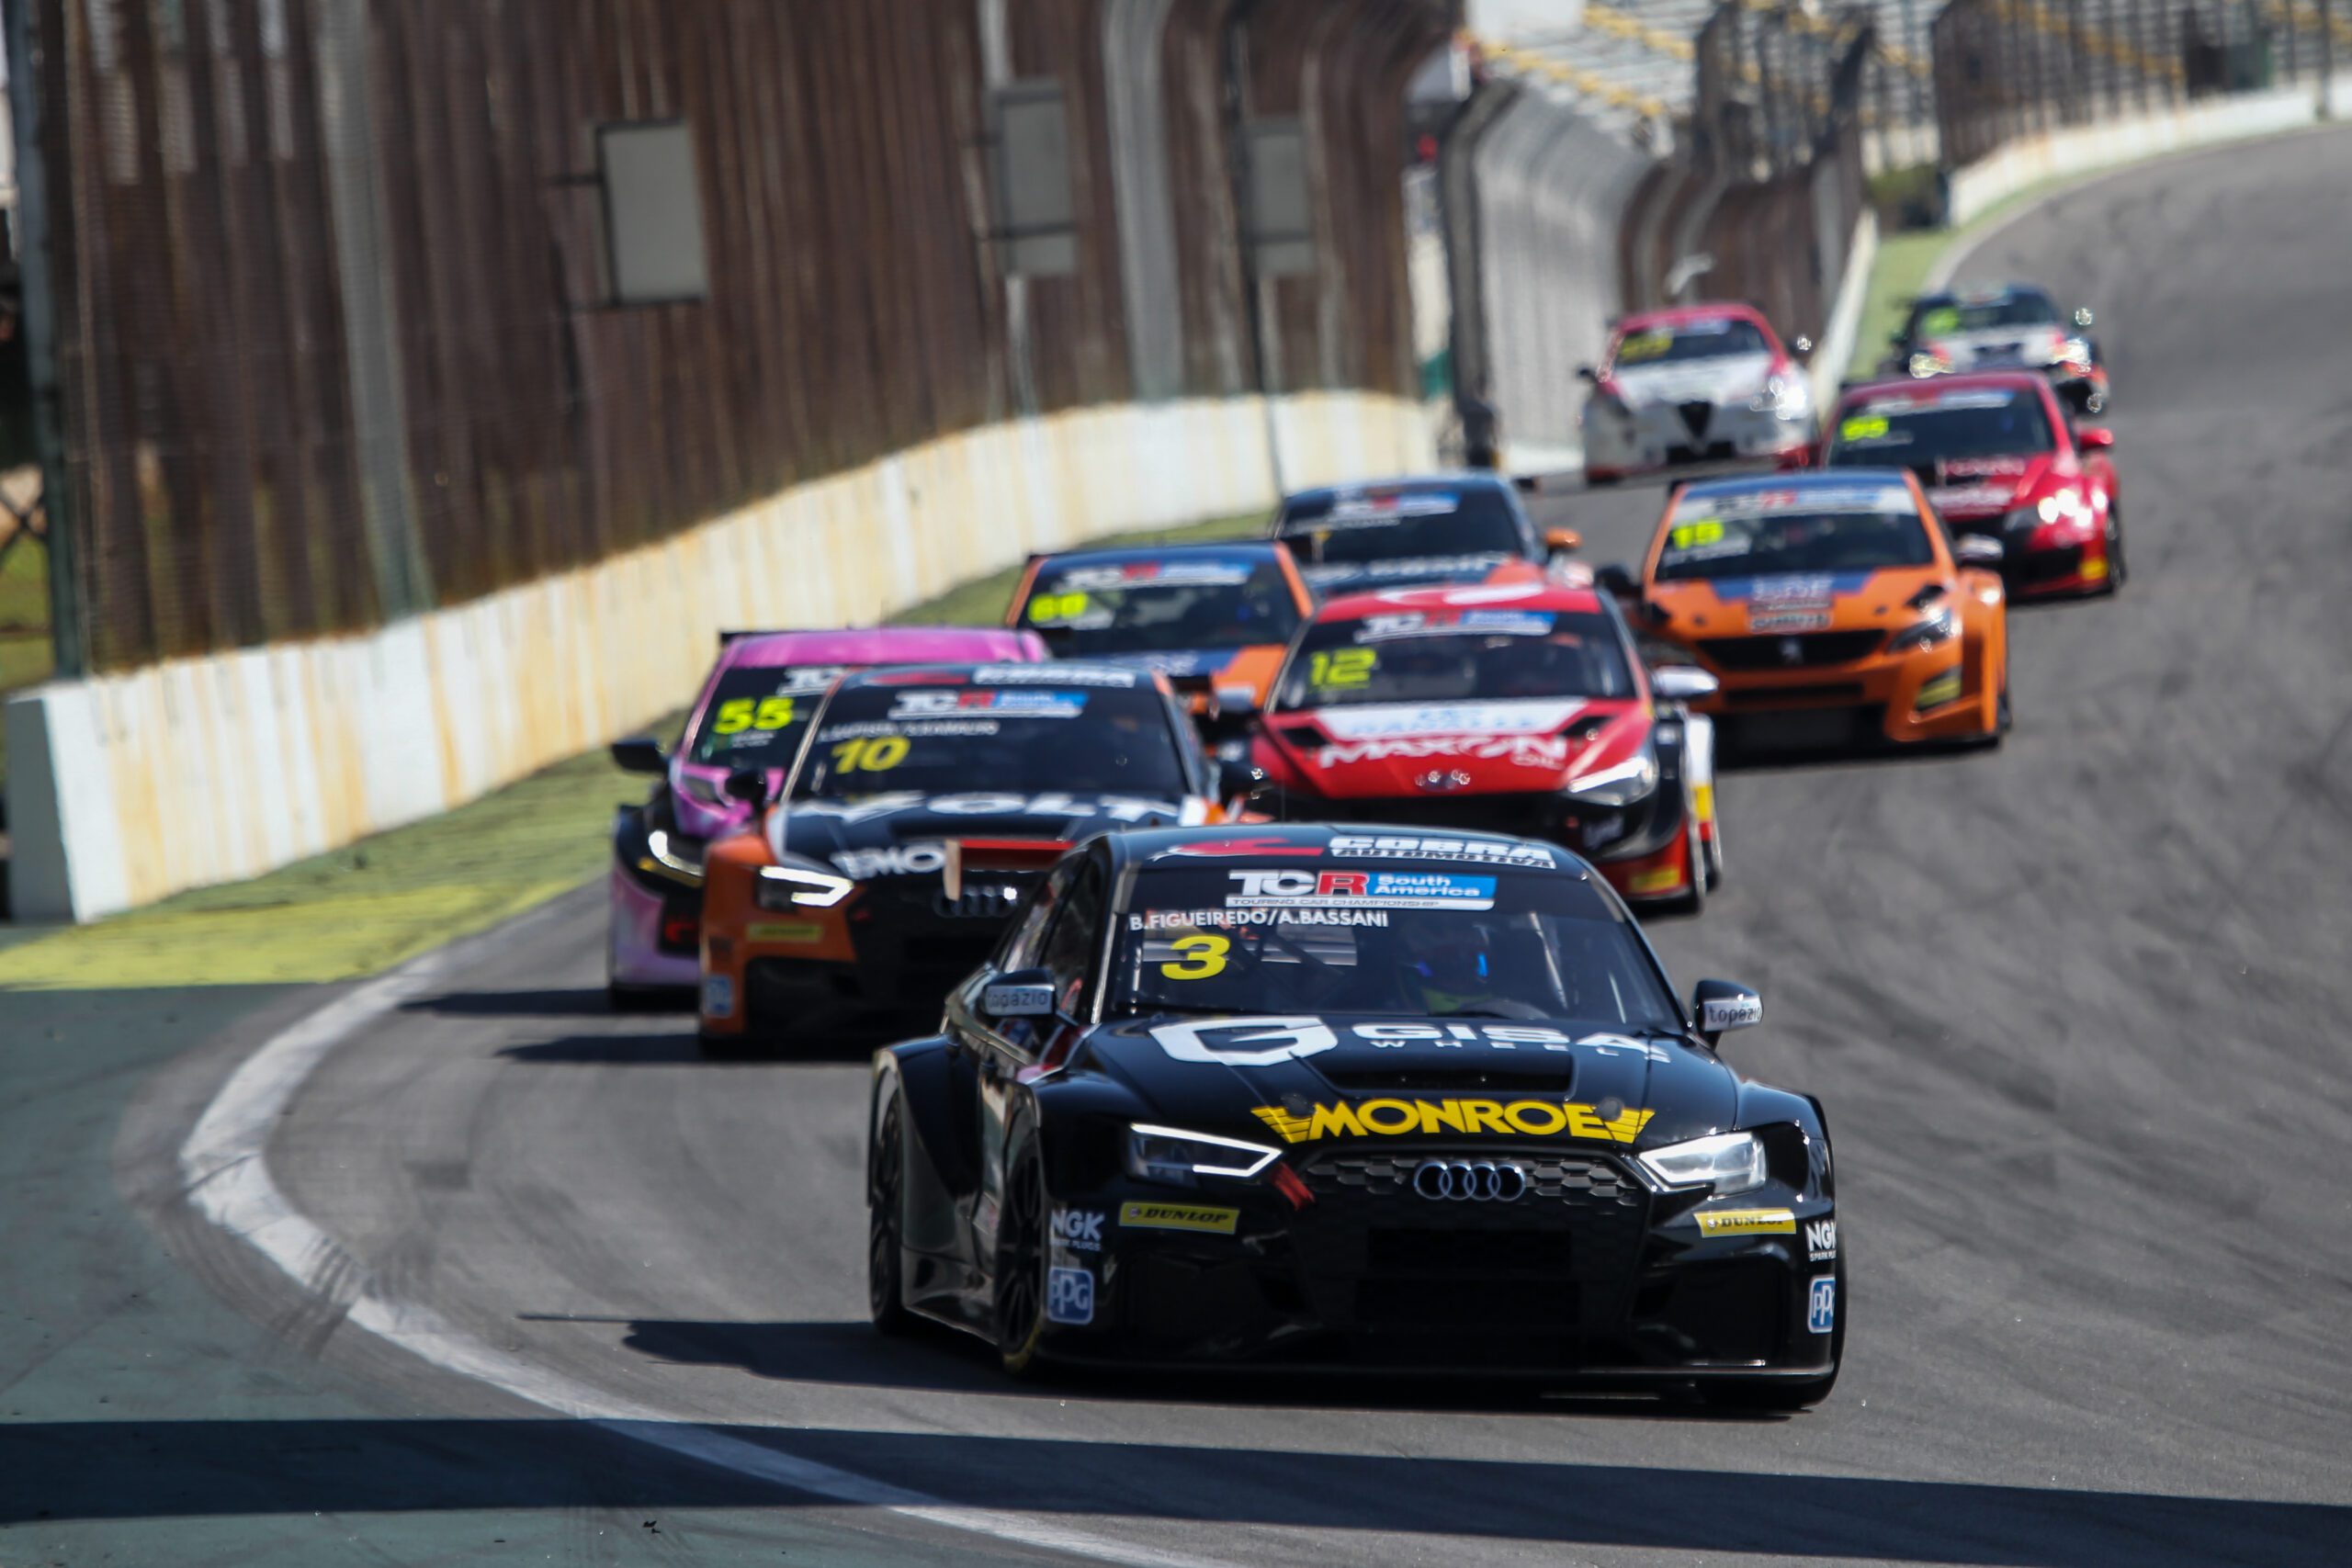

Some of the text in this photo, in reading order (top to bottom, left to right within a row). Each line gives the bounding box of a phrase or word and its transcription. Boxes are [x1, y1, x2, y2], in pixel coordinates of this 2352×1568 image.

[1309, 648, 1376, 686] 12
[713, 696, 794, 734] 55
[831, 737, 910, 774] 10
[1320, 736, 1566, 768] MAXON
[1329, 836, 1554, 861] COBRA
[1333, 849, 1555, 869] AUTOMOTIVA
[1229, 869, 1452, 897] TCR South
[1374, 885, 1481, 897] America
[1332, 898, 1440, 908] CHAMPIONSHIP
[1161, 934, 1231, 980] 3
[1352, 1023, 1670, 1055] GISA
[1308, 1099, 1612, 1140] MONROE
[1050, 1209, 1105, 1242] NGK
[1145, 1207, 1228, 1223] DUNLOP
[1049, 1273, 1089, 1314] PPG
